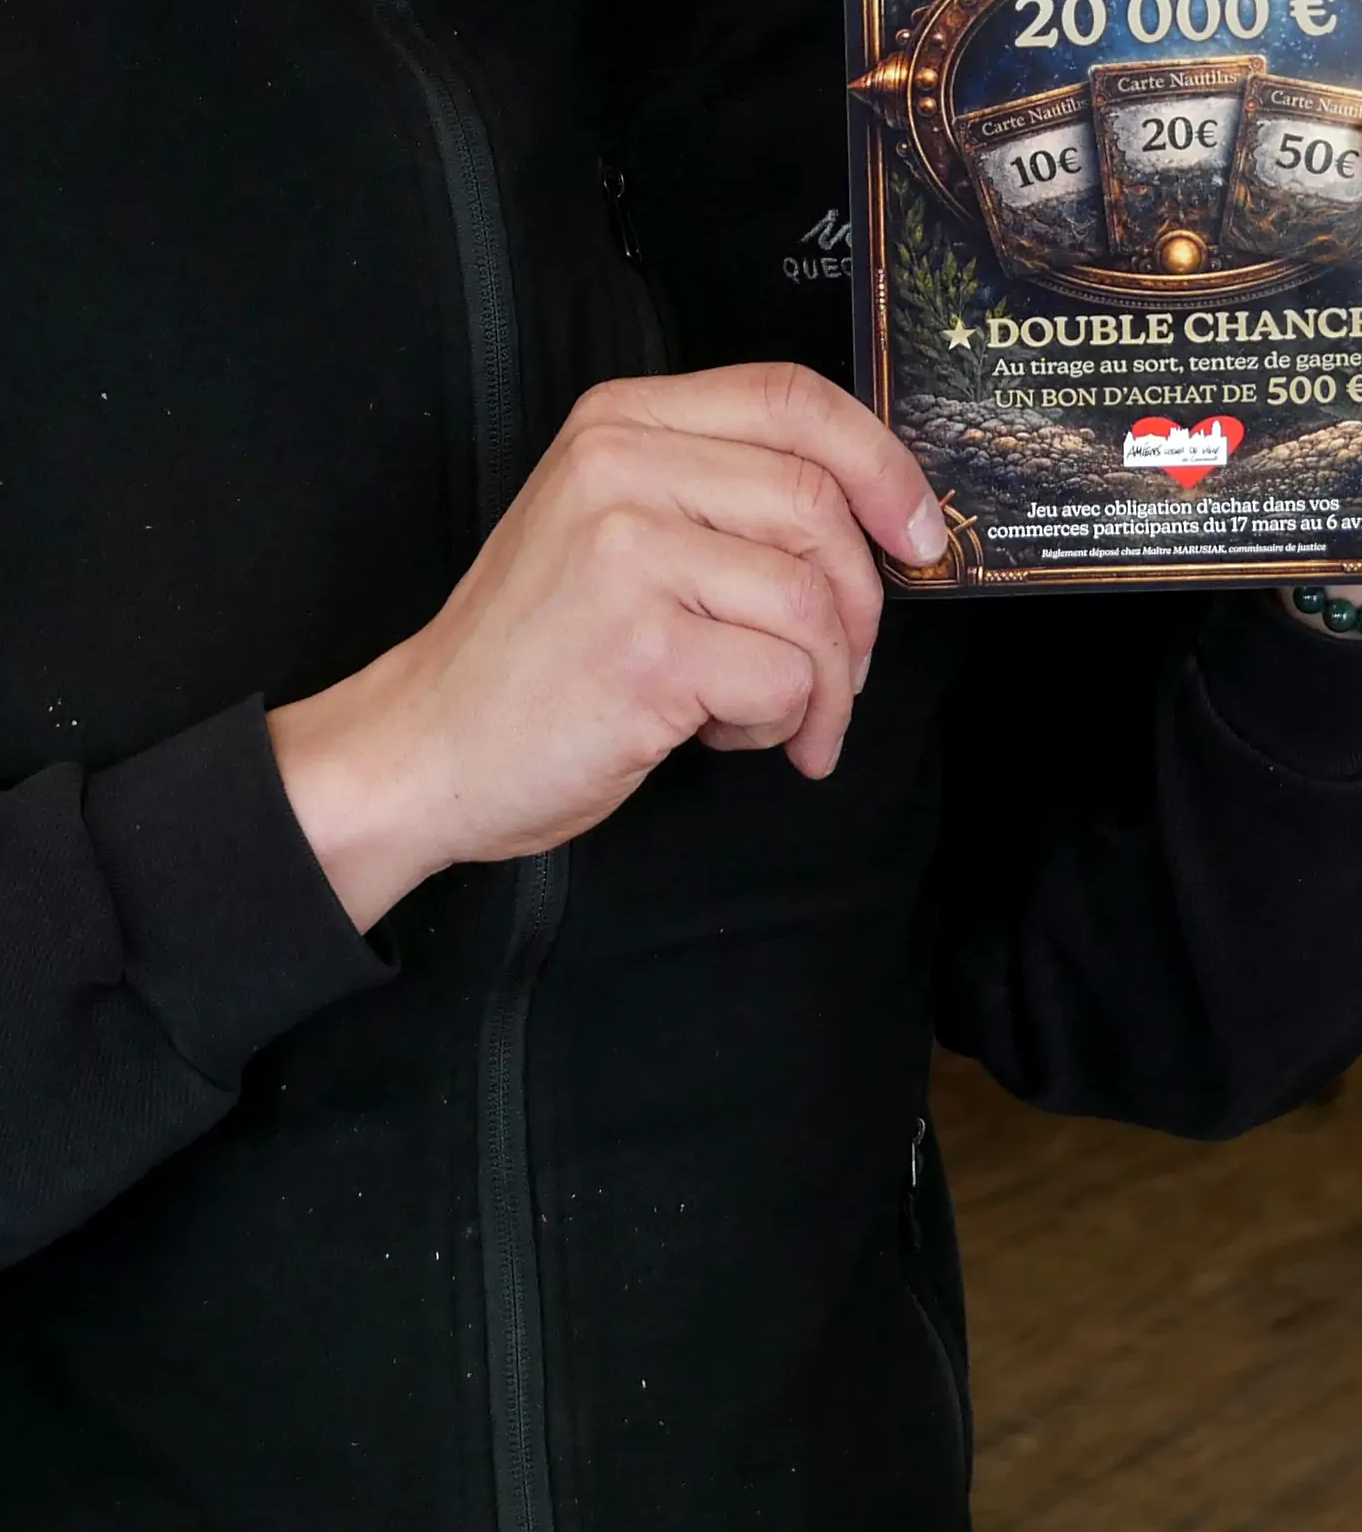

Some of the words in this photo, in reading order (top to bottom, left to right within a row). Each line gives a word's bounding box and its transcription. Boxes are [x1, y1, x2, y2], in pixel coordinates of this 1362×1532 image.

[1118, 76, 1165, 92] Carte
[1271, 90, 1314, 109] Carte
[981, 115, 1026, 136] Carte
[1141, 116, 1219, 152] 20€
[1010, 146, 1083, 189] 10€
[1275, 133, 1361, 179] 50€
[783, 256, 851, 283] QUEC
[987, 313, 1174, 348] DOUBLE
[992, 358, 1025, 376] Au
[1030, 357, 1095, 378] tirage
[1100, 359, 1128, 373] au
[1133, 356, 1184, 374] sort,
[1189, 354, 1259, 372] tentez
[1264, 350, 1290, 369] de
[994, 388, 1035, 408] UN
[1041, 387, 1098, 408] BON
[1103, 384, 1217, 406] D'ACHAT
[1222, 383, 1257, 403] DE
[1267, 375, 1337, 406] 500
[1027, 502, 1058, 518] Jeu
[1061, 504, 1101, 517] avec
[1104, 499, 1193, 518] obligation
[1196, 497, 1259, 514] d'achat
[1263, 497, 1306, 512] dans
[1308, 498, 1339, 511] vos
[988, 523, 1089, 539] commerces
[1093, 519, 1199, 538] participants
[1203, 518, 1227, 533] du
[1230, 516, 1248, 532] 17
[1252, 517, 1297, 532] mars
[1300, 518, 1323, 531] au
[1326, 514, 1338, 529] 6
[1042, 547, 1088, 559] Règlement
[1089, 547, 1119, 558] déposé
[1121, 547, 1140, 556] chez
[1228, 543, 1284, 554] commissaire
[1286, 544, 1296, 553] de
[1297, 542, 1327, 553] justice
